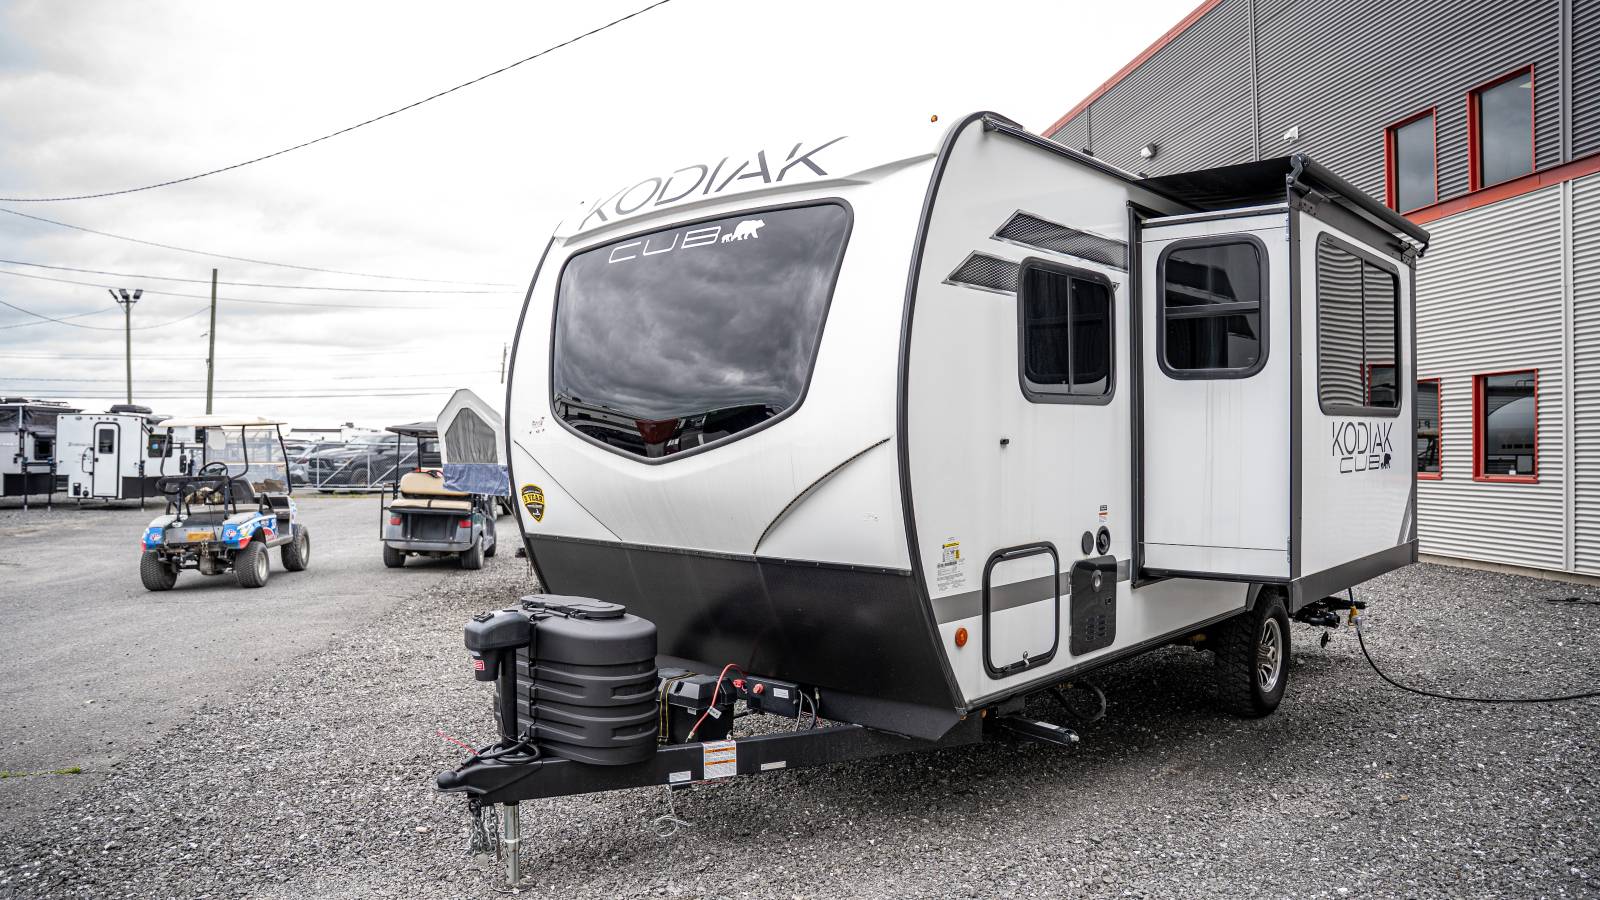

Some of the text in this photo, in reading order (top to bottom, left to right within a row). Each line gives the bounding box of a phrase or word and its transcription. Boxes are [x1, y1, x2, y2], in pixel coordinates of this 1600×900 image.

[578, 136, 848, 230] KODIAK
[608, 226, 722, 264] CUB
[1332, 421, 1393, 456] KODIAK
[1340, 455, 1381, 474] CUB
